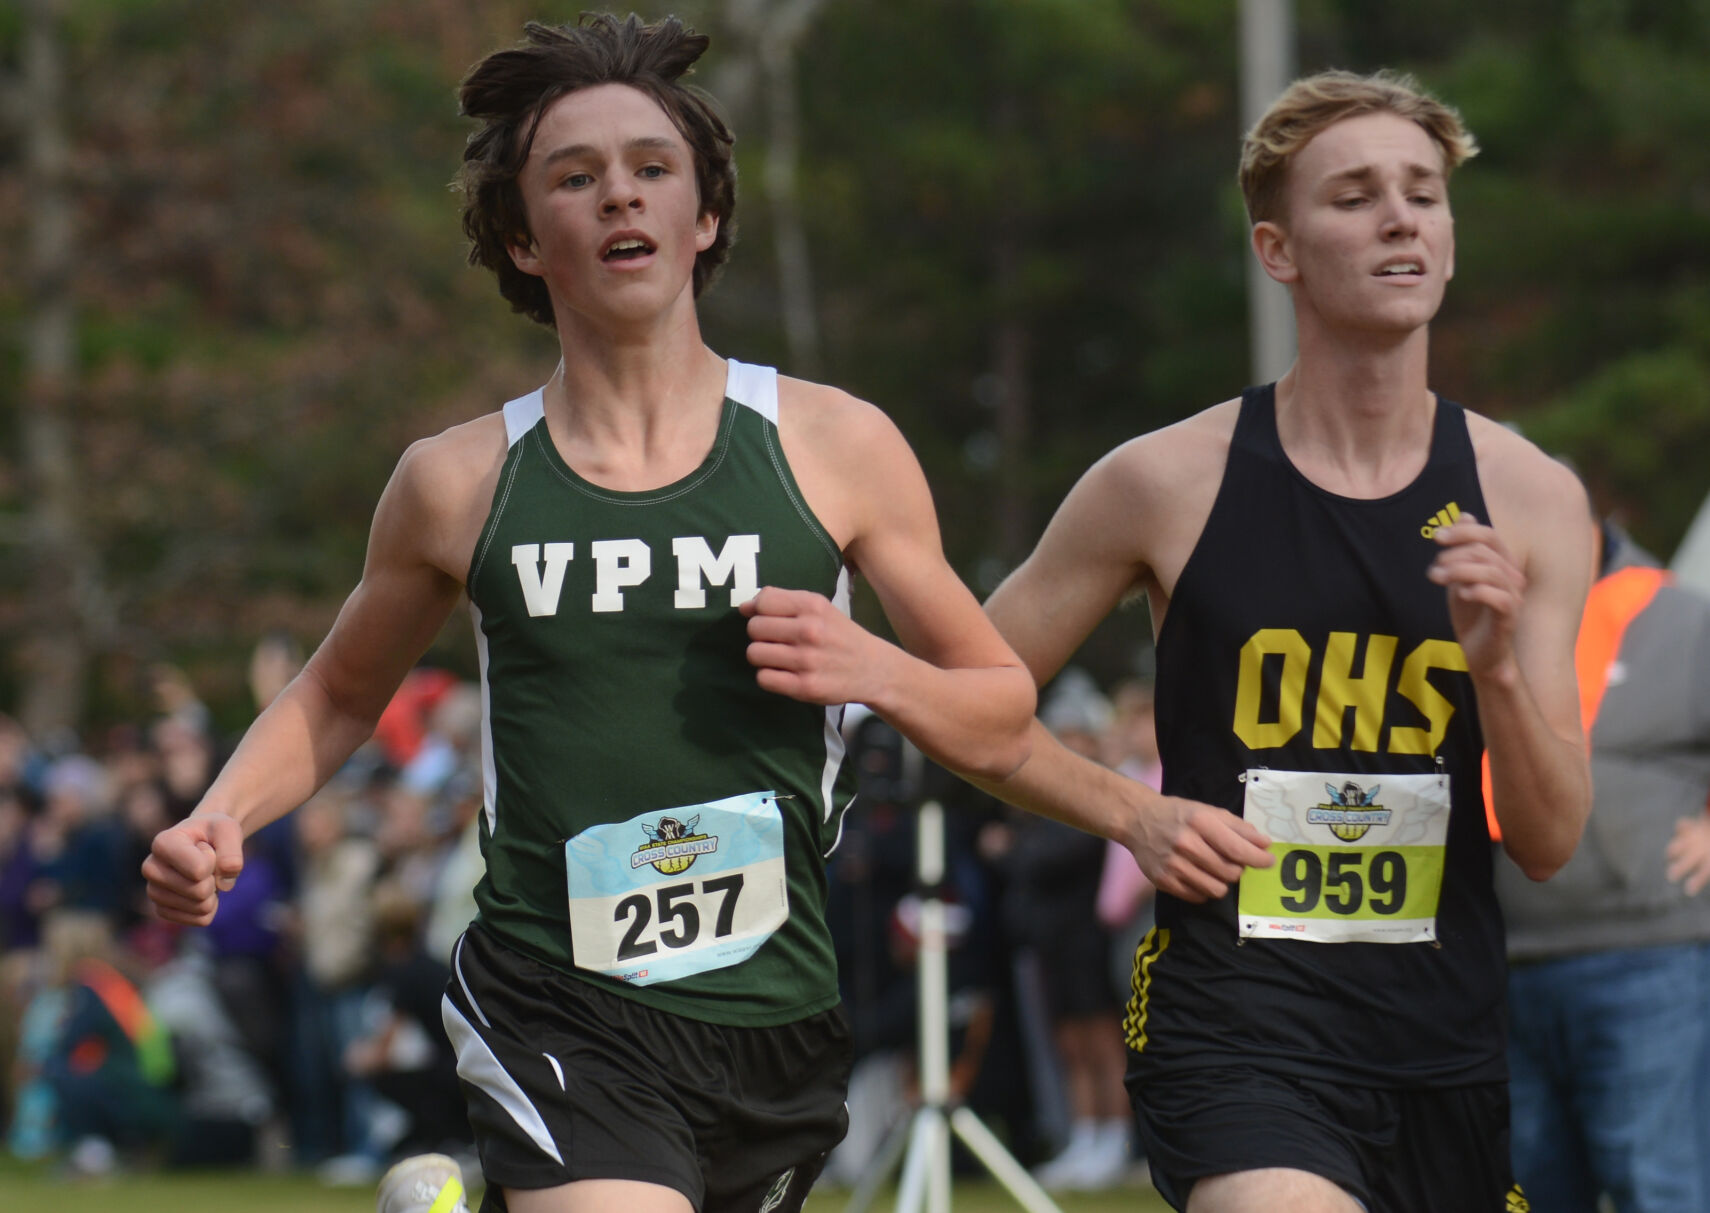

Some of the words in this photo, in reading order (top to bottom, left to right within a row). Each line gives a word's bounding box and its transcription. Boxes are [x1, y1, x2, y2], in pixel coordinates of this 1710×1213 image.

[511, 534, 760, 618] VPM
[1232, 628, 1471, 758] OHS
[633, 847, 665, 866] CROSS
[667, 837, 715, 857] COUNTRY
[1309, 810, 1343, 822] CROSS
[1345, 811, 1391, 823] COUNTRY
[614, 873, 744, 962] 257
[1280, 849, 1407, 915] 959
